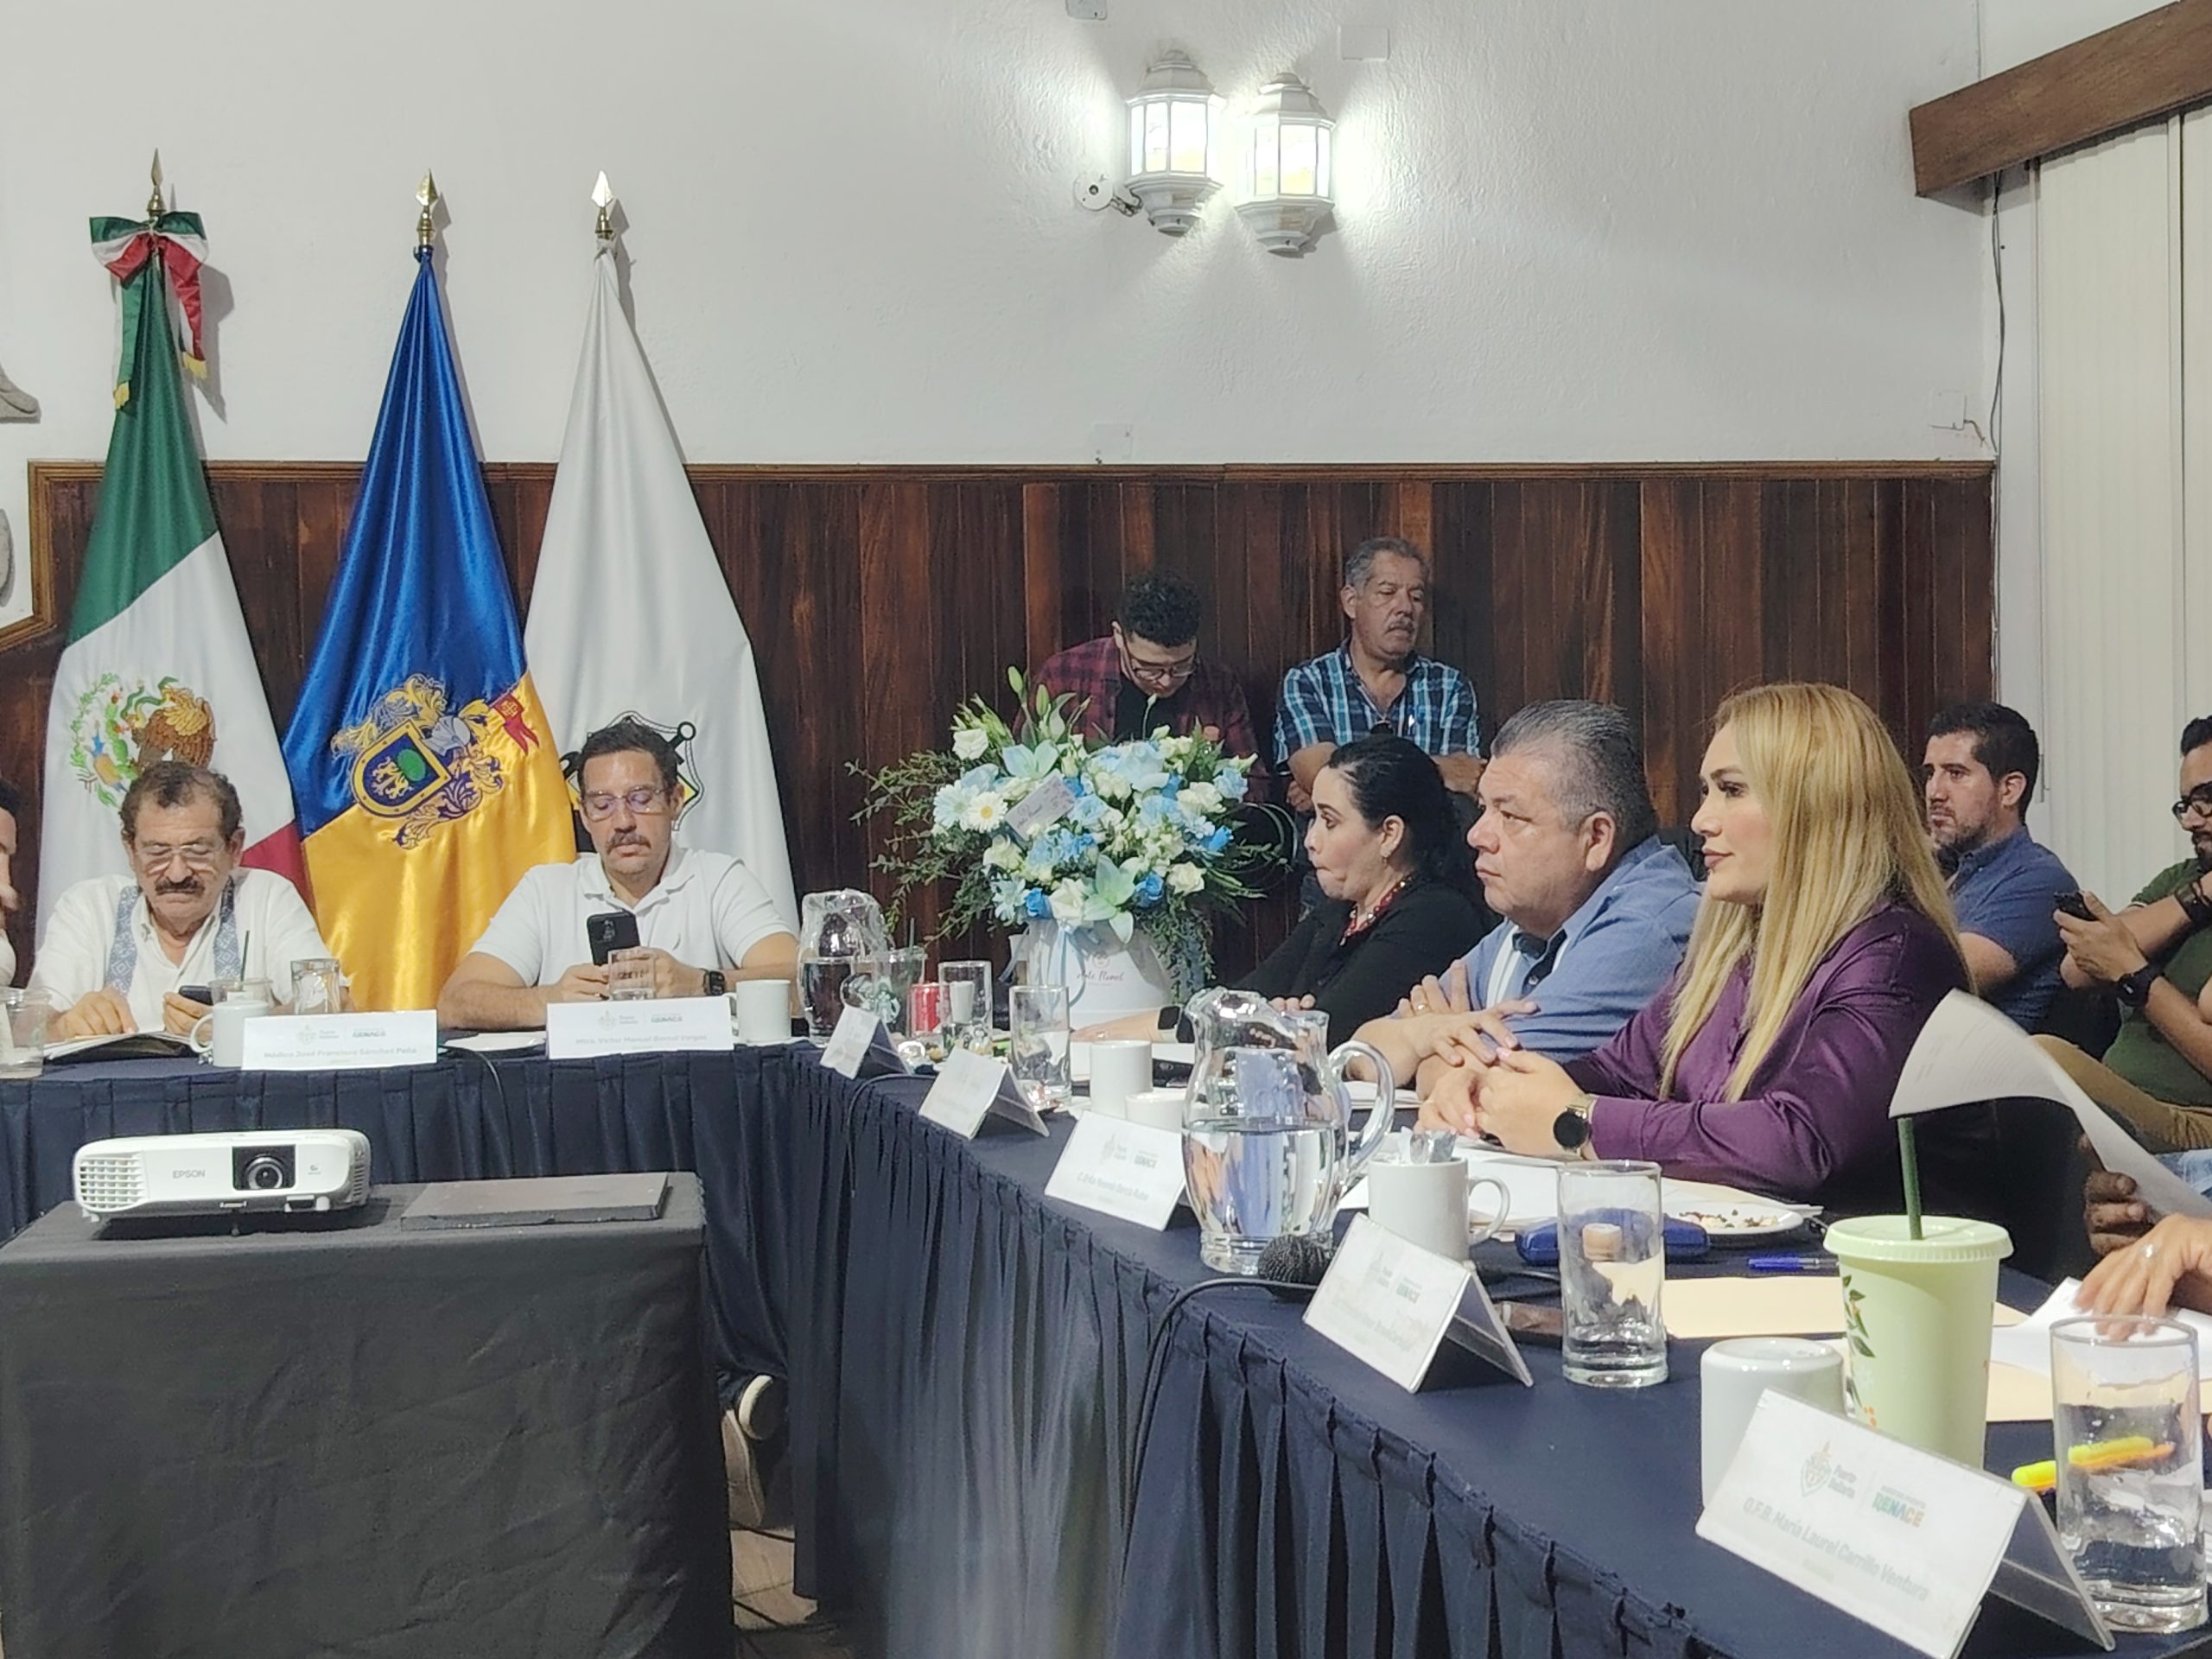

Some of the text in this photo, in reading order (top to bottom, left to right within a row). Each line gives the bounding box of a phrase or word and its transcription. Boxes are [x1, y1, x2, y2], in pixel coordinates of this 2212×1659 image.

[172, 1169, 206, 1179] EPSON
[1872, 1491, 1925, 1529] RENACE
[1801, 1525, 1841, 1556] Laurel
[1879, 1563, 1930, 1602] Ventura
